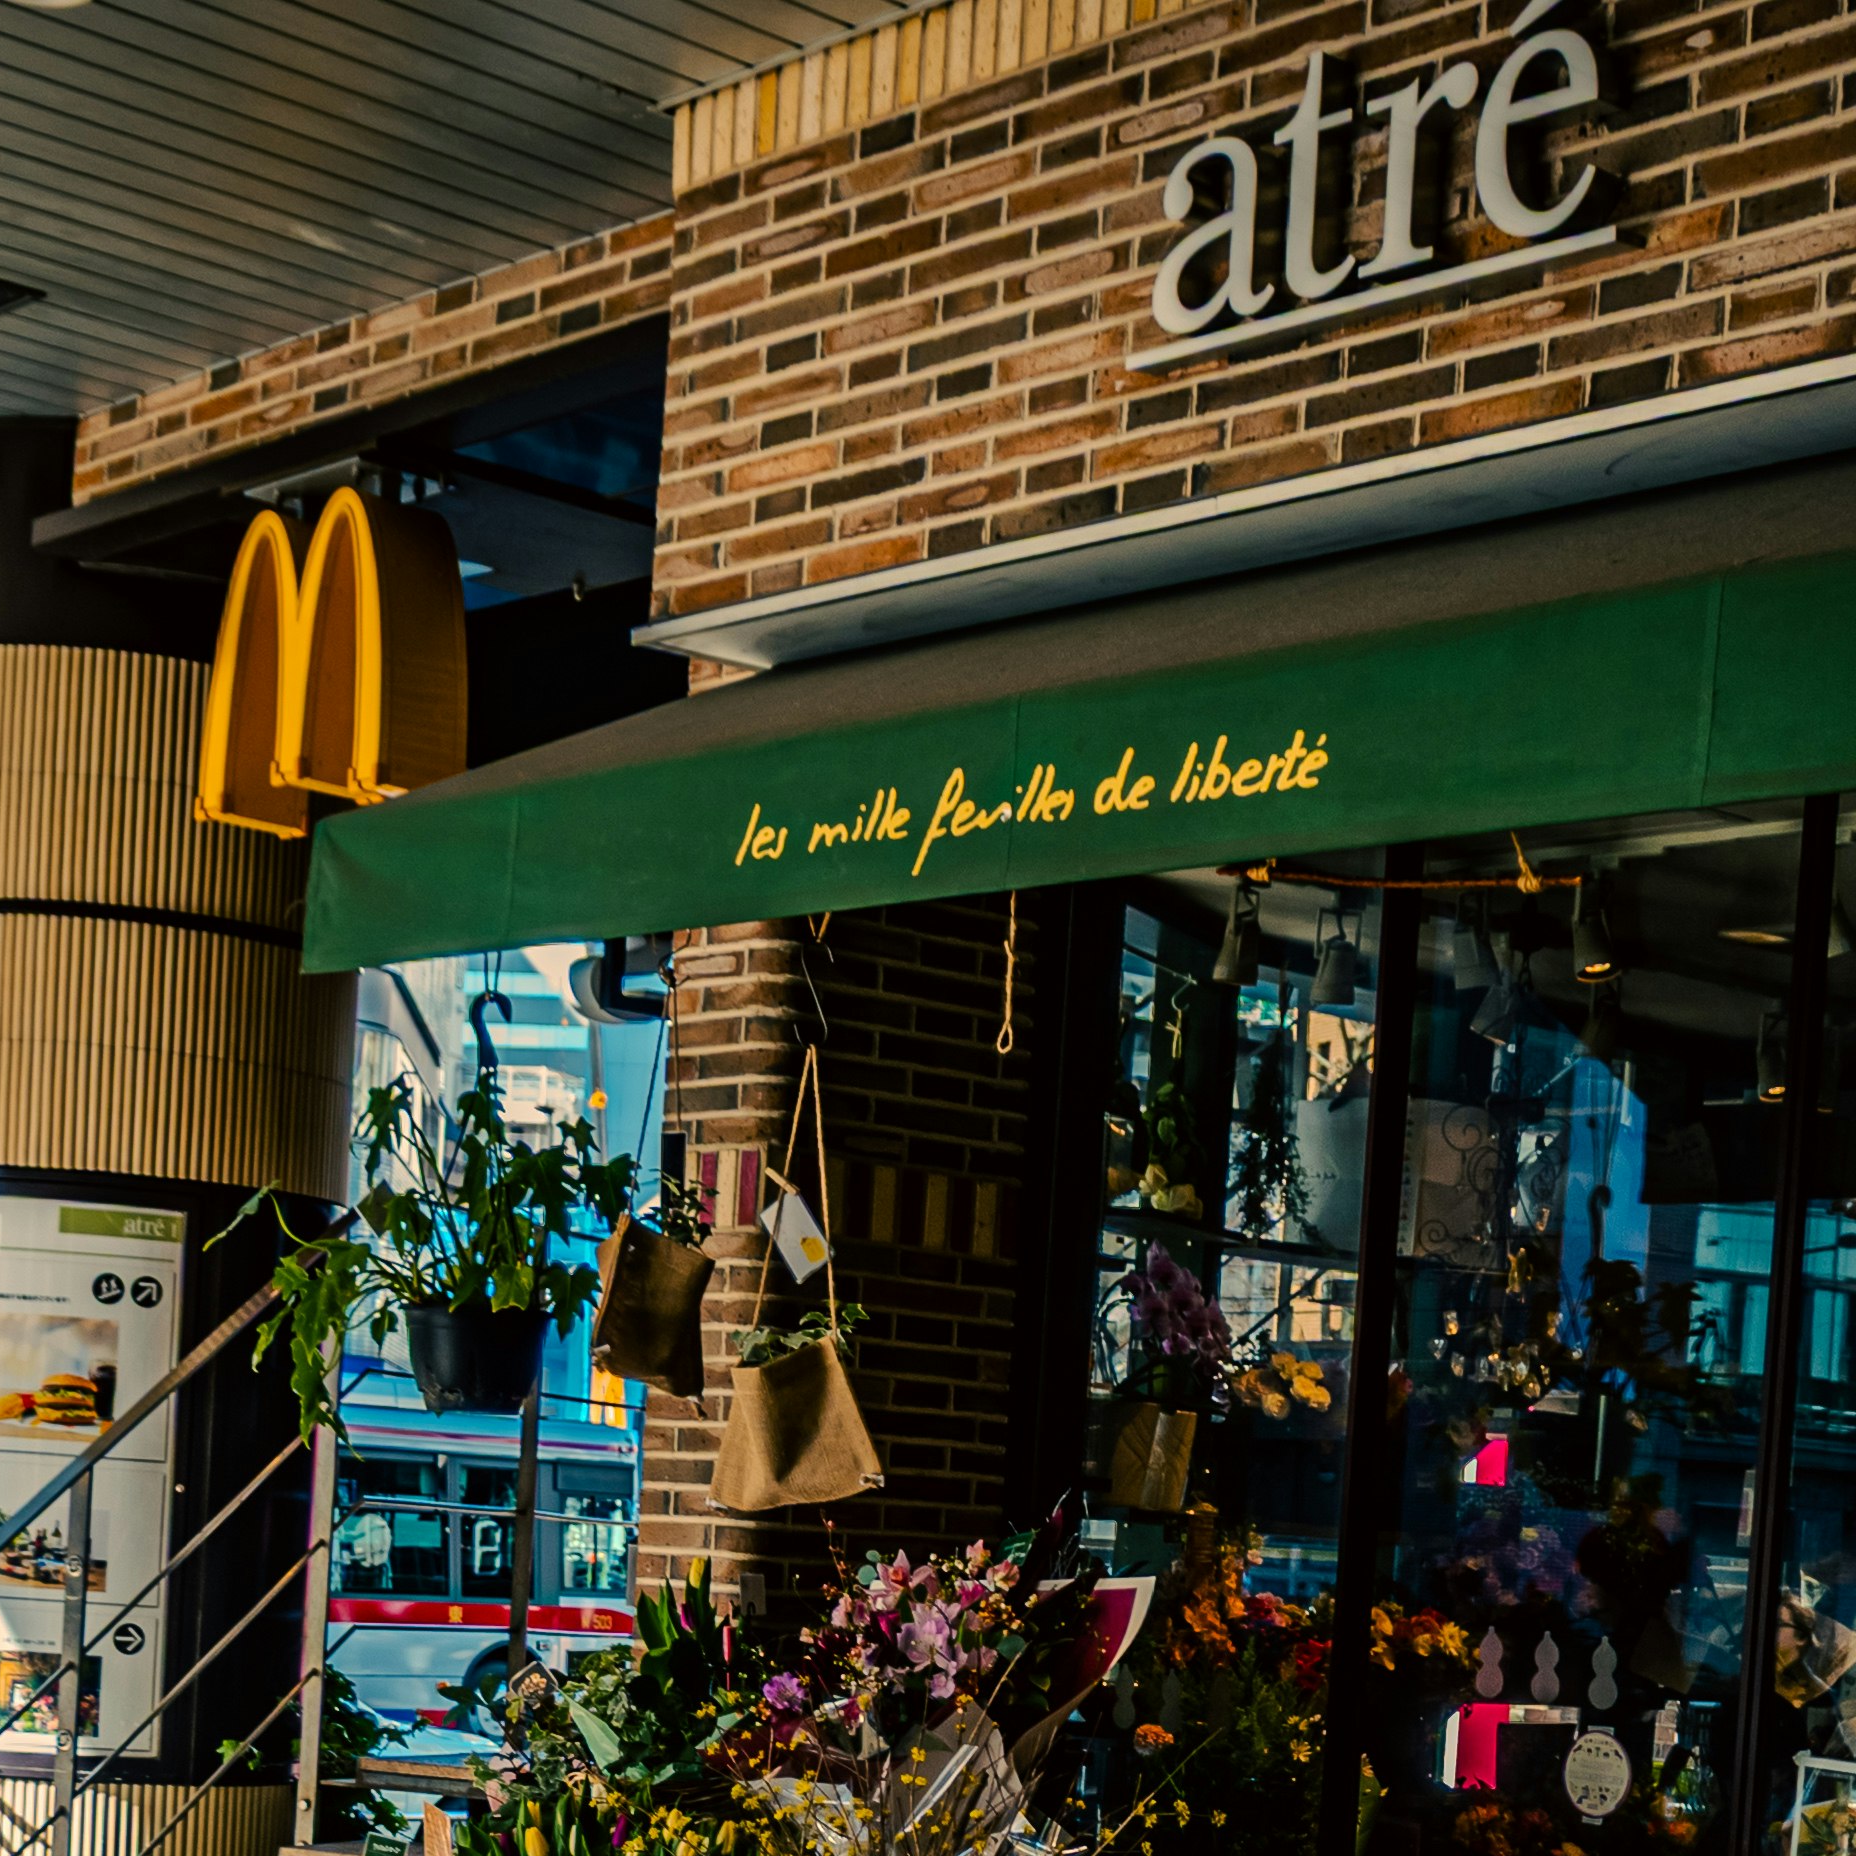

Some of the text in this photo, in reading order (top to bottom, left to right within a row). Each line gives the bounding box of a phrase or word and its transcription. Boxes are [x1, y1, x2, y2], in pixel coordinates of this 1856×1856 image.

[1151, 0, 1599, 336] atré
[735, 803, 787, 866] les
[808, 787, 909, 854] mille
[1094, 746, 1156, 815] de
[1170, 729, 1329, 803] liberté
